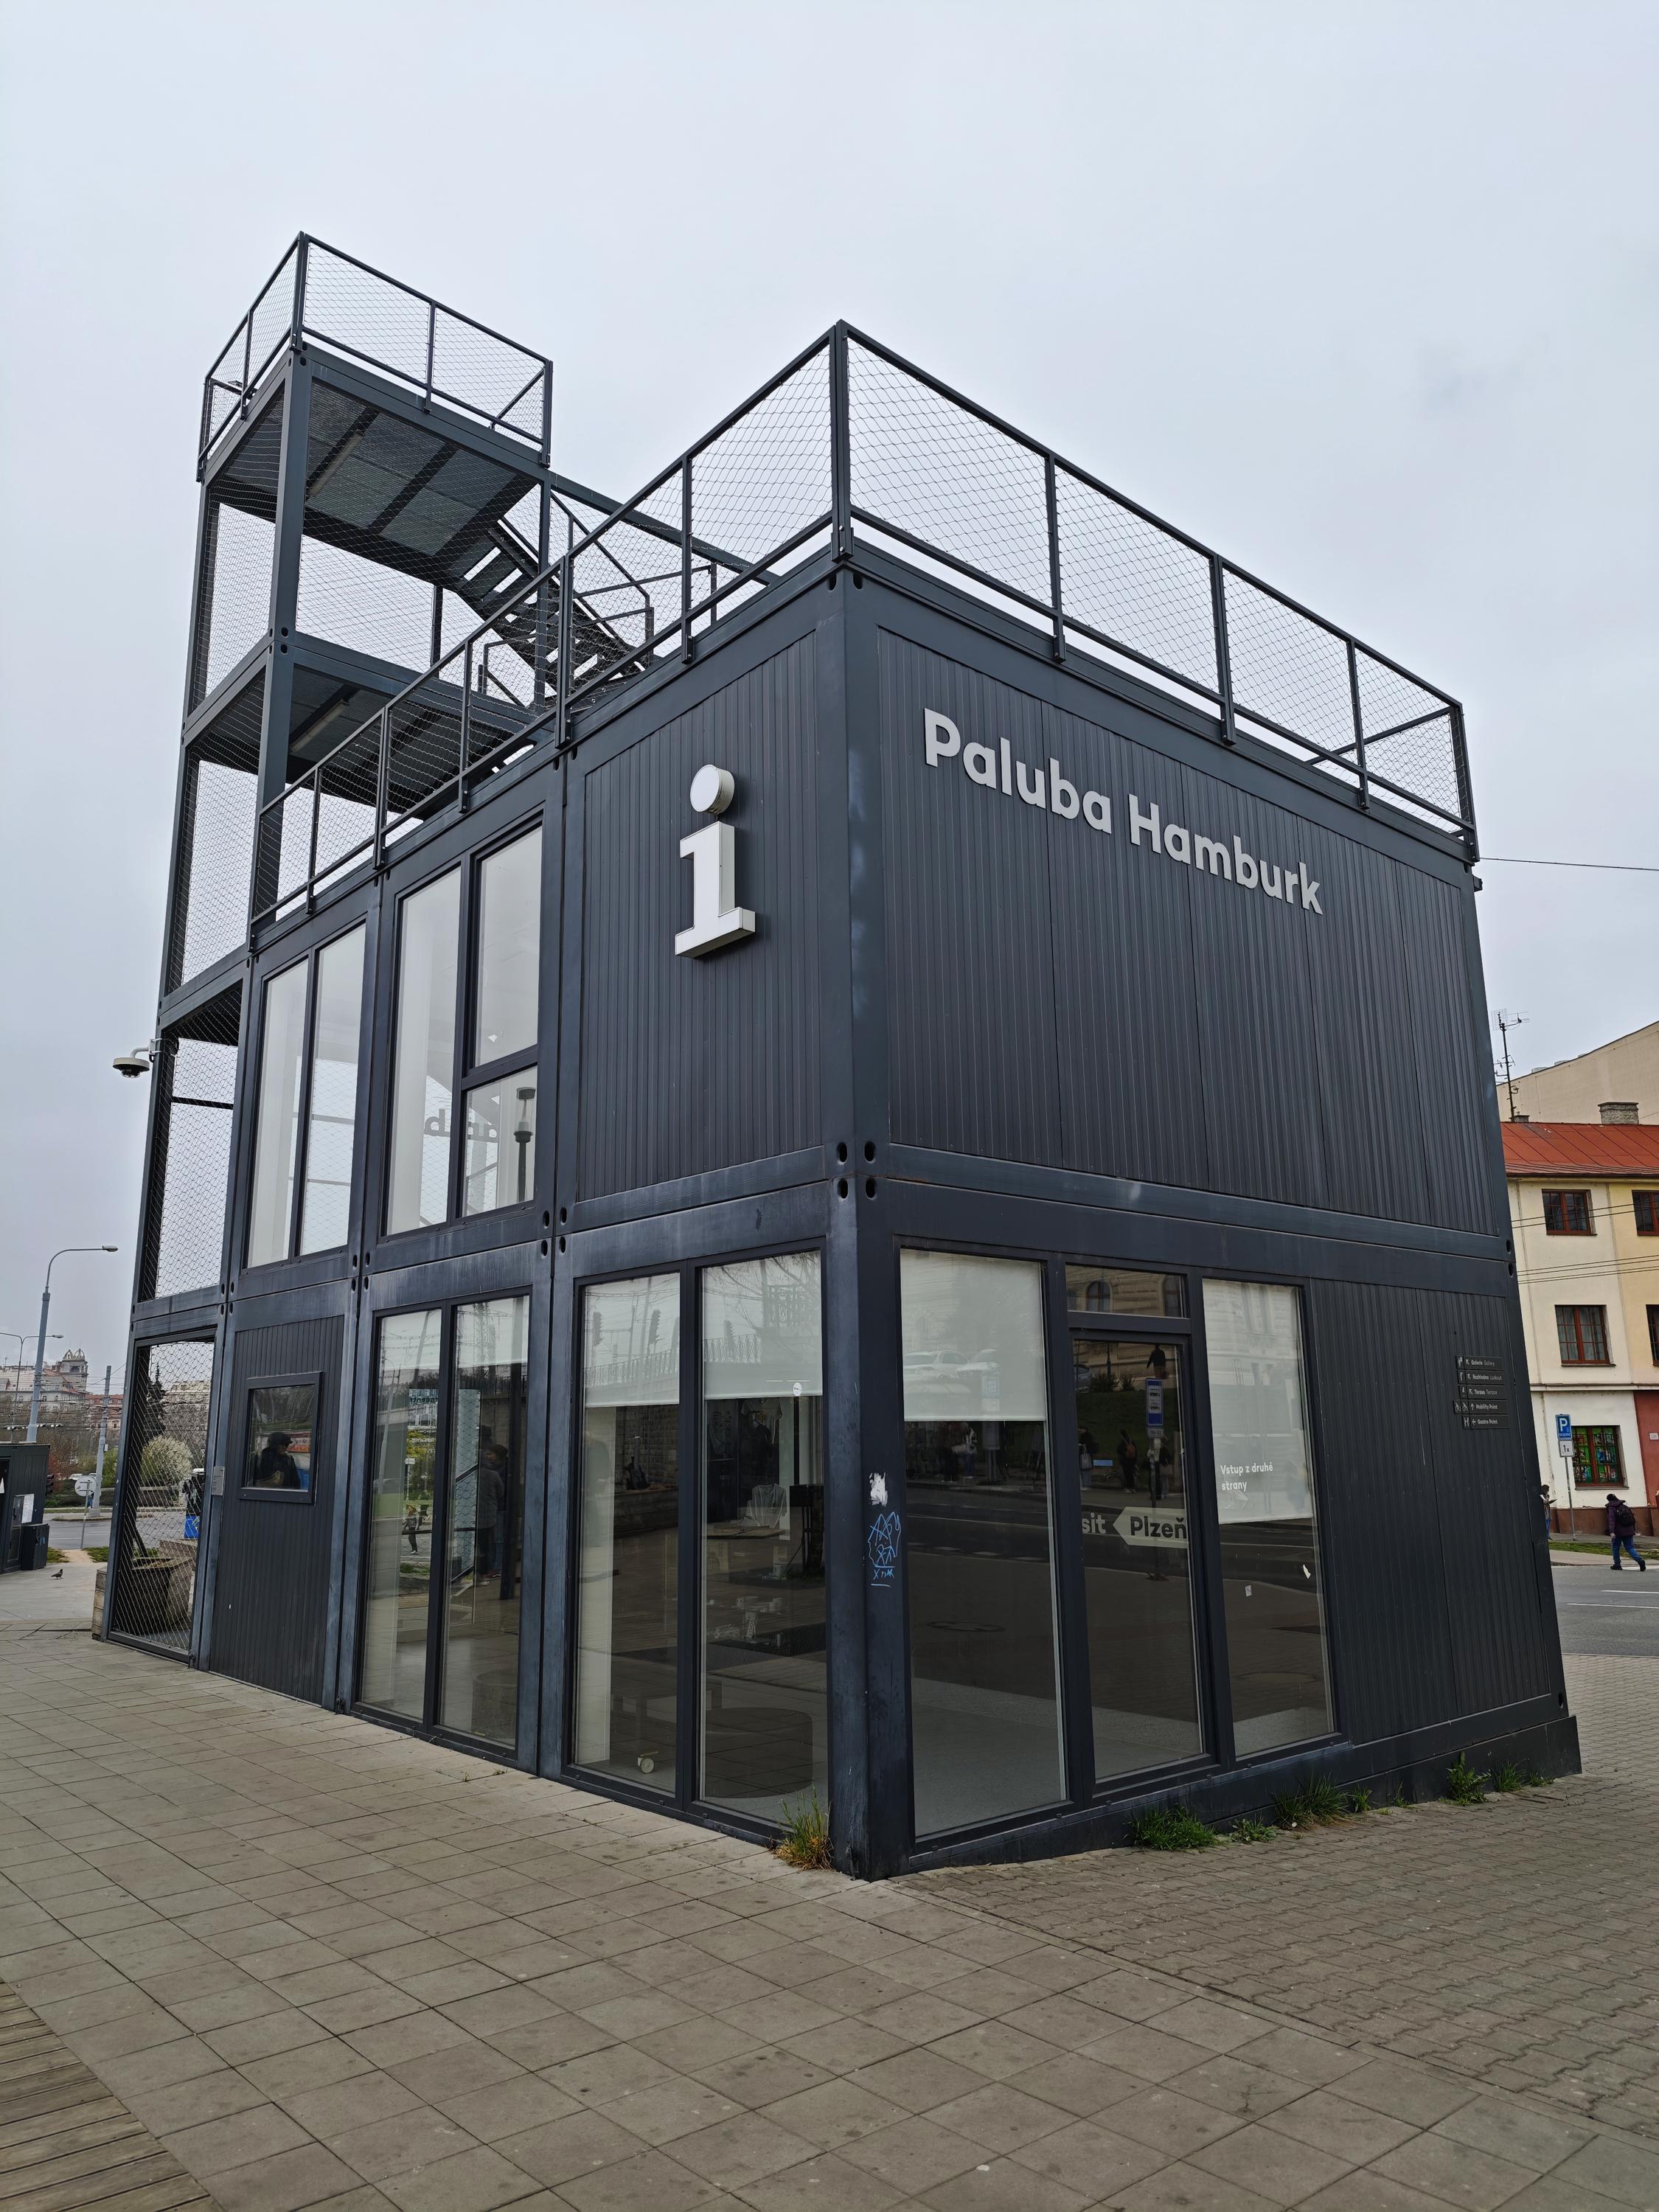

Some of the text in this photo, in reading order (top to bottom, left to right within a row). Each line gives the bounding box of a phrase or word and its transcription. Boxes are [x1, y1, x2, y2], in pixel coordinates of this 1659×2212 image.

[924, 708, 1324, 915] Paluba Hamburk
[1559, 1417, 1568, 1432] P
[1562, 1444, 1571, 1453] 1x
[1220, 1461, 1273, 1476] Vstup z druhé
[1221, 1481, 1248, 1492] strany
[1130, 1515, 1186, 1539] Plzeň
